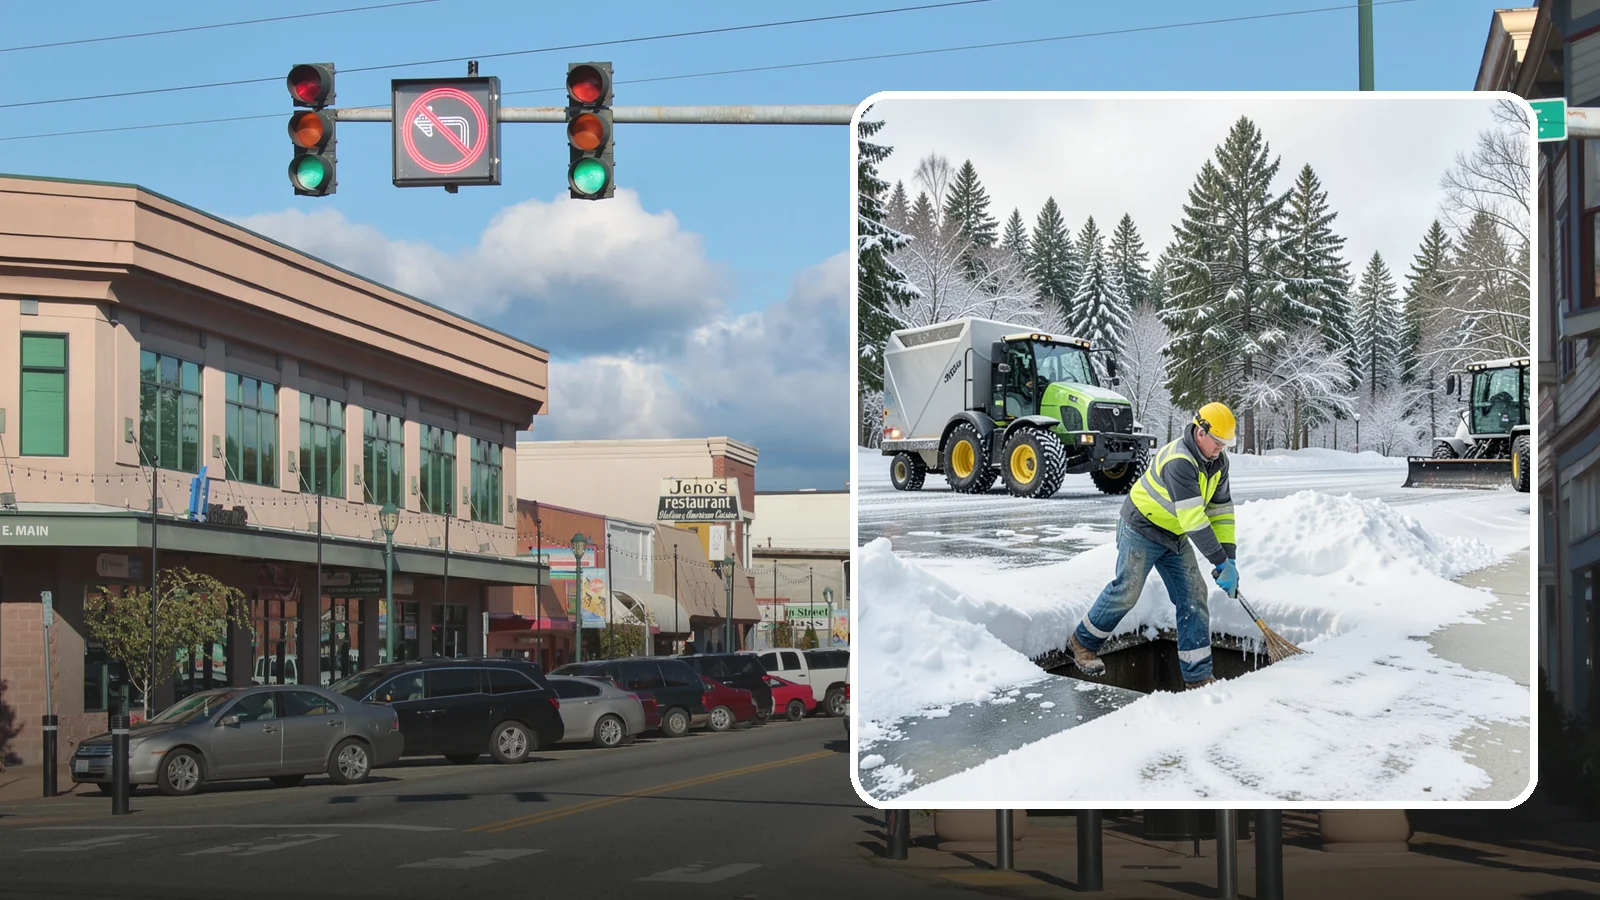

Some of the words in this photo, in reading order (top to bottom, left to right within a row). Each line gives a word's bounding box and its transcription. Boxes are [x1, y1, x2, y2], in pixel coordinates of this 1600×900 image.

[670, 480, 727, 494] Jeno's
[664, 496, 731, 509] restaurant
[658, 510, 681, 519] Italian
[686, 509, 714, 519] American
[715, 509, 737, 519] Cuisine
[2, 525, 13, 536] E.
[15, 525, 49, 536] MAIN
[797, 607, 828, 617] Street
